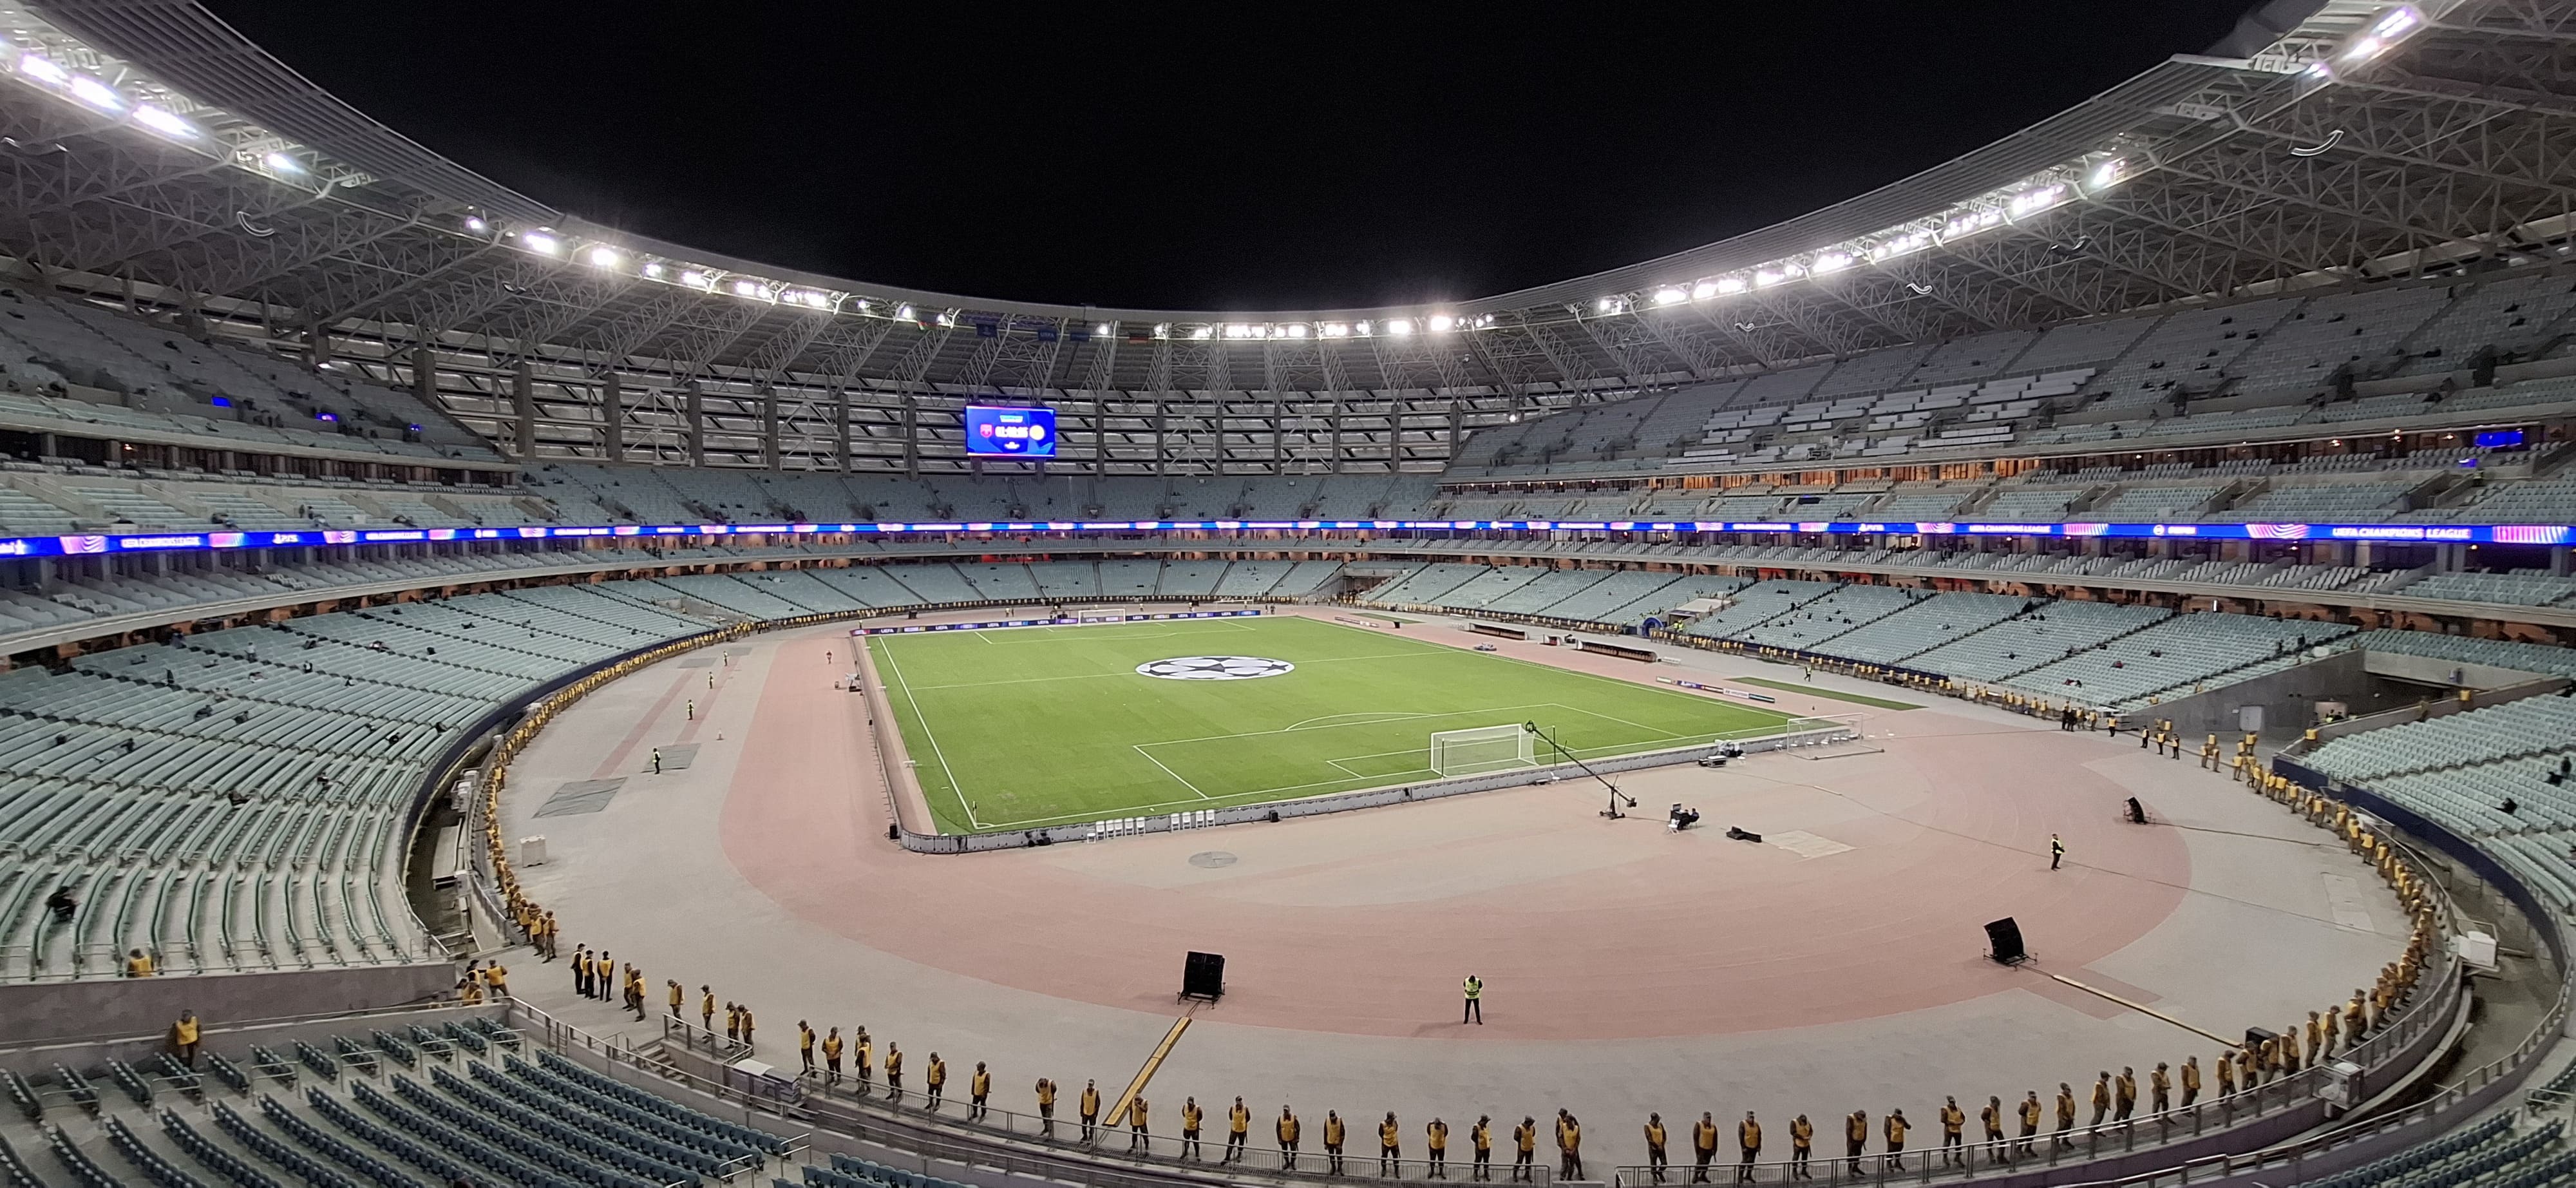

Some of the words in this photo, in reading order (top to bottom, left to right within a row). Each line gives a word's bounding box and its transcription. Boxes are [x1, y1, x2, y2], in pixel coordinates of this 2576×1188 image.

[2333, 528, 2358, 536] UEFA
[2359, 528, 2423, 537] CHAMPIONS
[2426, 529, 2470, 539] LEAGUE
